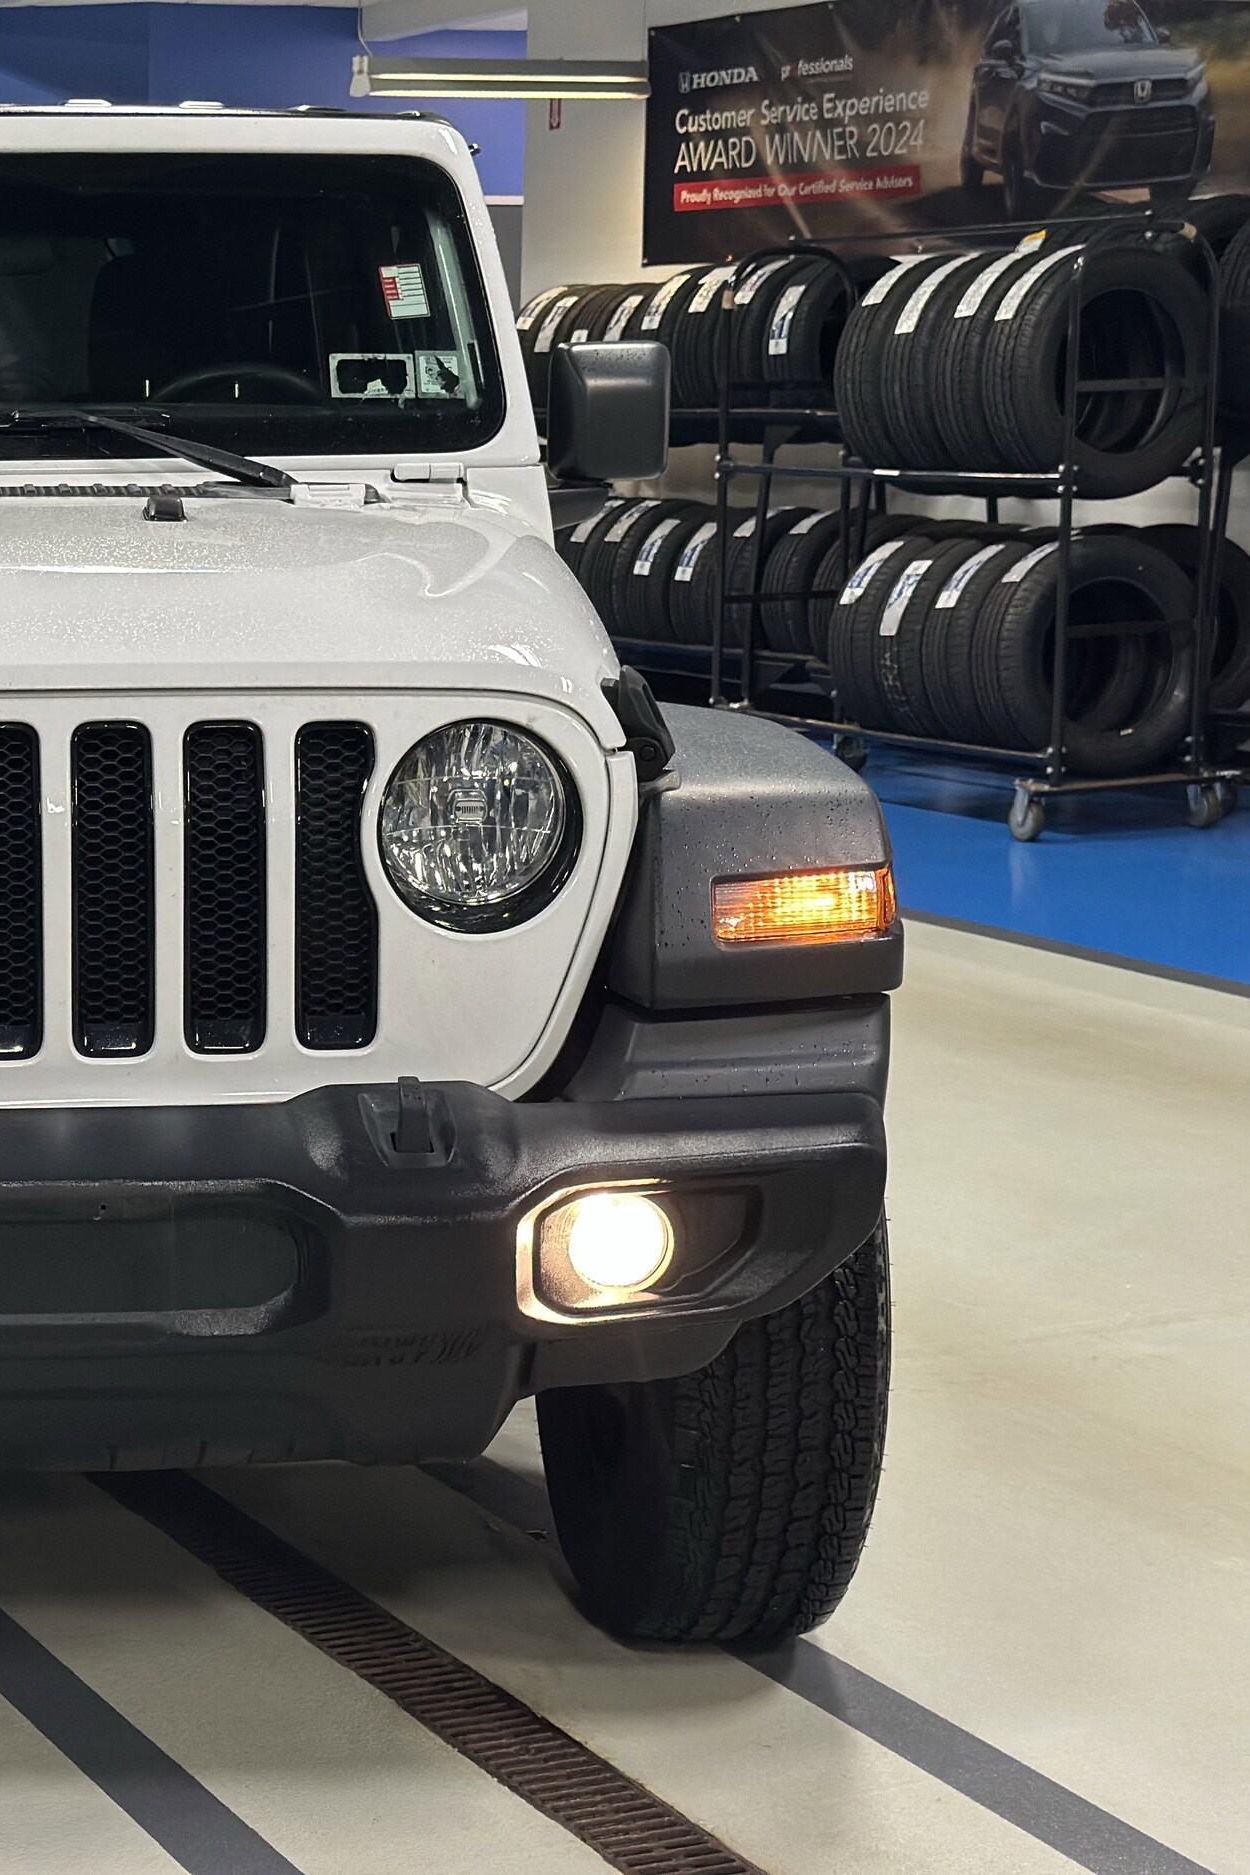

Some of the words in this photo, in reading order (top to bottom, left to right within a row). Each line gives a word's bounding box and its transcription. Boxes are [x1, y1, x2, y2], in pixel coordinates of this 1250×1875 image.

[692, 66, 759, 90] HONDA
[675, 108, 755, 134] Customer
[760, 96, 818, 125] Service
[823, 87, 929, 124] Experience
[673, 136, 756, 174] AWARD
[765, 127, 860, 165] WINNER
[866, 119, 925, 157] 2024
[713, 184, 762, 204] Recognized
[763, 183, 775, 197] for
[777, 184, 797, 196] Our
[798, 180, 837, 196] Certified
[838, 178, 873, 193] Service
[875, 176, 913, 190] Advisors
